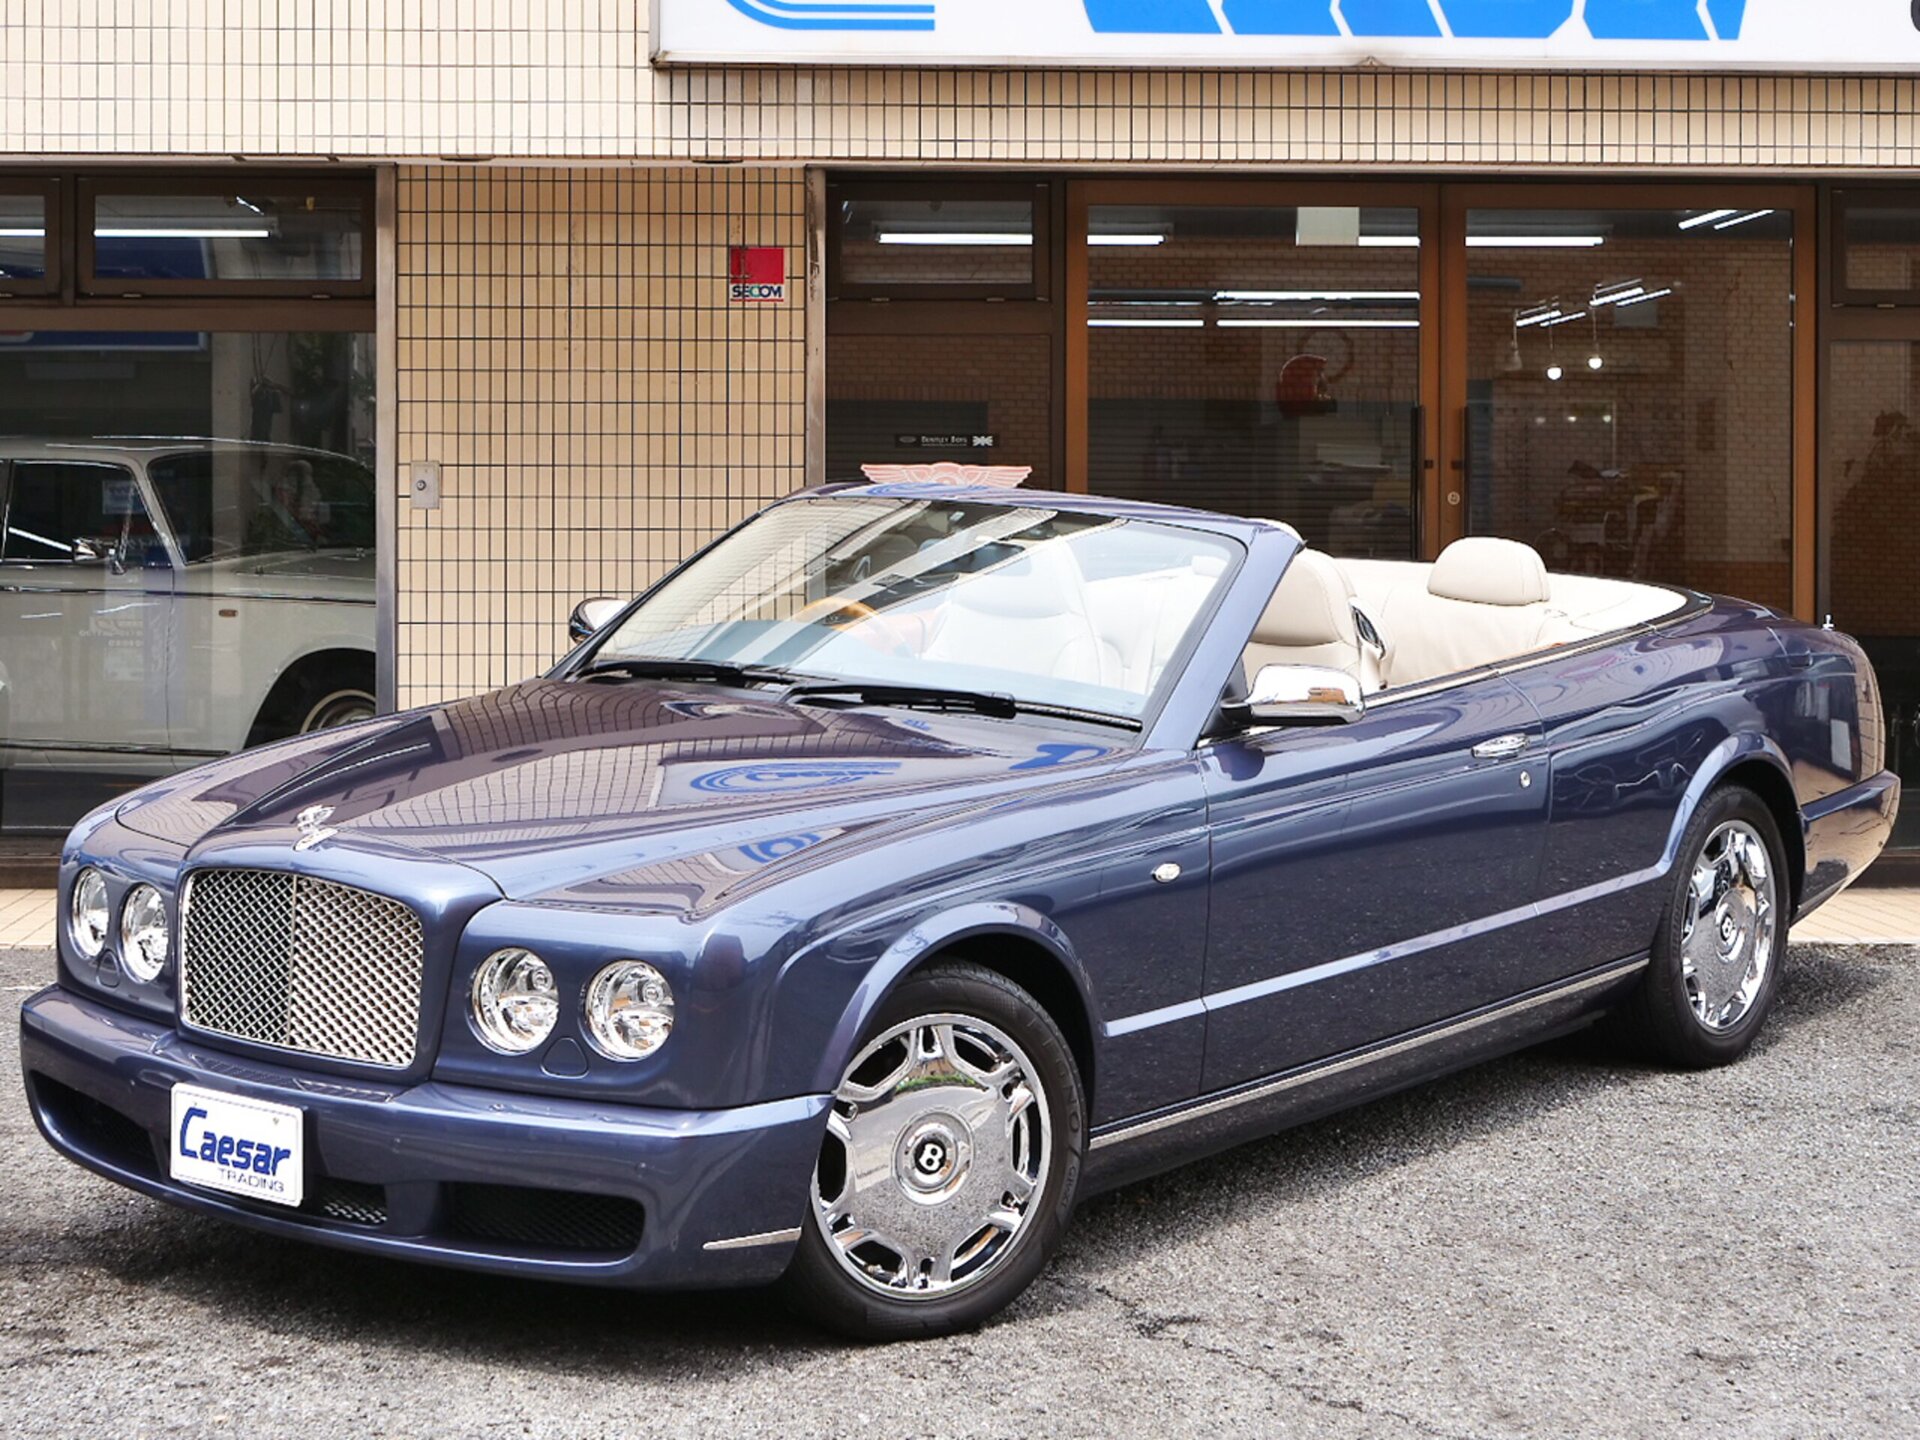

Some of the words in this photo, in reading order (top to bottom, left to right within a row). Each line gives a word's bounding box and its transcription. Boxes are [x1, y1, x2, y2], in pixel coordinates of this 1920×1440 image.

[732, 285, 782, 298] SECOM
[180, 1106, 291, 1176] Caesar
[218, 1168, 284, 1193] TRADING
